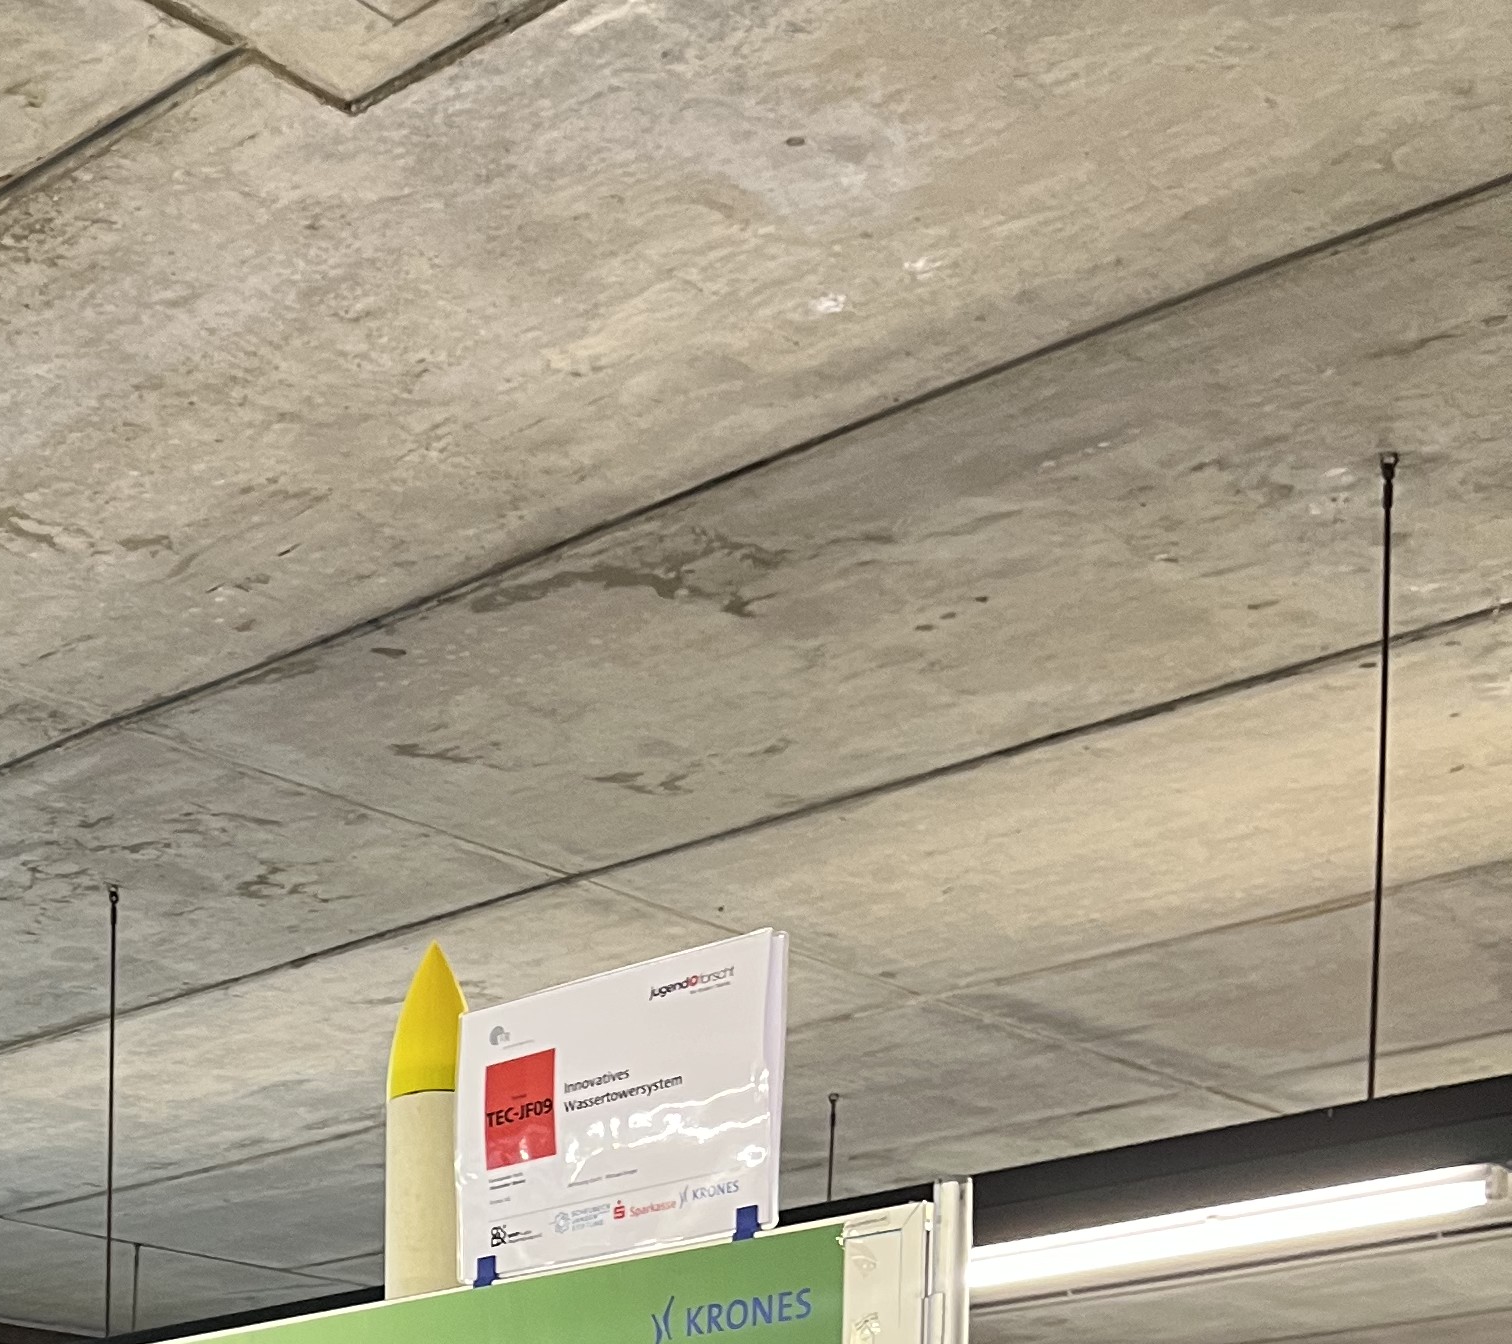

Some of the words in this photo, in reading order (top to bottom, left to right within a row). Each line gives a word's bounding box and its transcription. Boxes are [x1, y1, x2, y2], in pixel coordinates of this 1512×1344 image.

[563, 1068, 630, 1094] Innovatives
[563, 1075, 683, 1113] Wassertowersystem
[486, 1098, 553, 1128] TEC-JF09
[691, 1180, 740, 1201] KRONES
[629, 1200, 677, 1218] Sparkasse
[686, 1287, 812, 1337] KRONES
